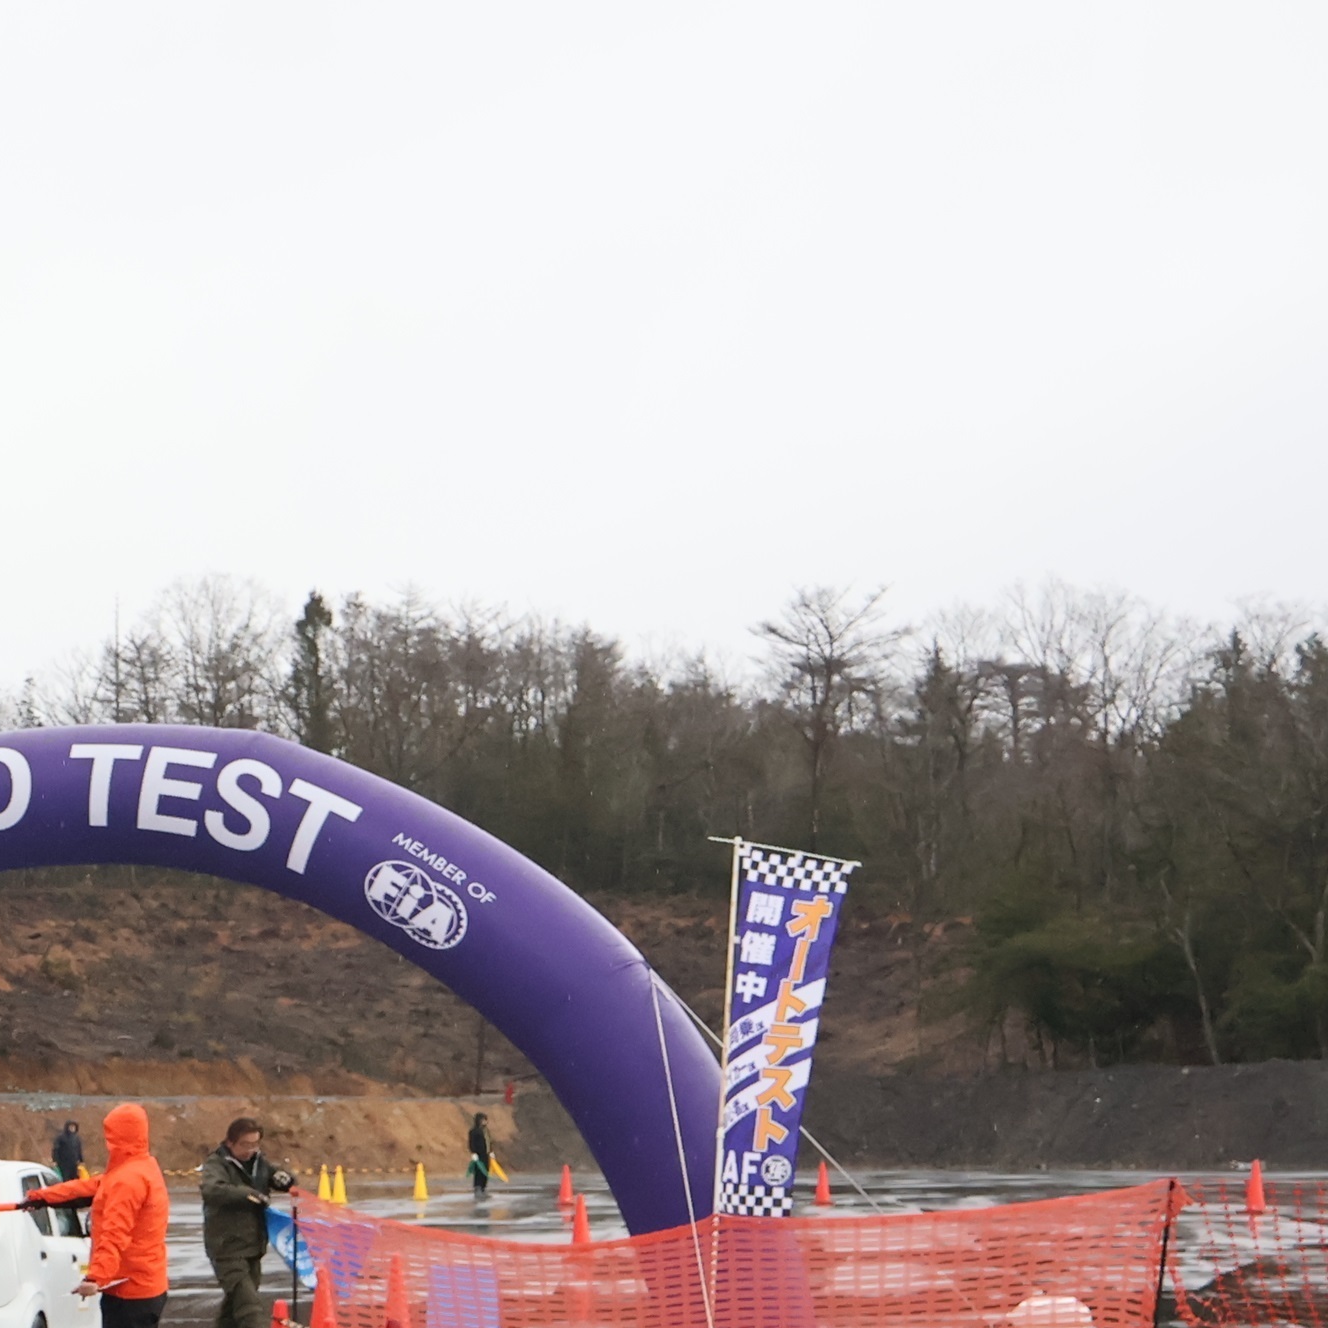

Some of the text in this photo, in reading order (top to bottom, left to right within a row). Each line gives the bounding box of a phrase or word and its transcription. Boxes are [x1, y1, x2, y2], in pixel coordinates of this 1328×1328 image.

[69, 743, 363, 874] TEST
[392, 832, 497, 904] MEMBER OF
[753, 894, 834, 1152] オートテスト
[722, 1150, 762, 1185] AF
